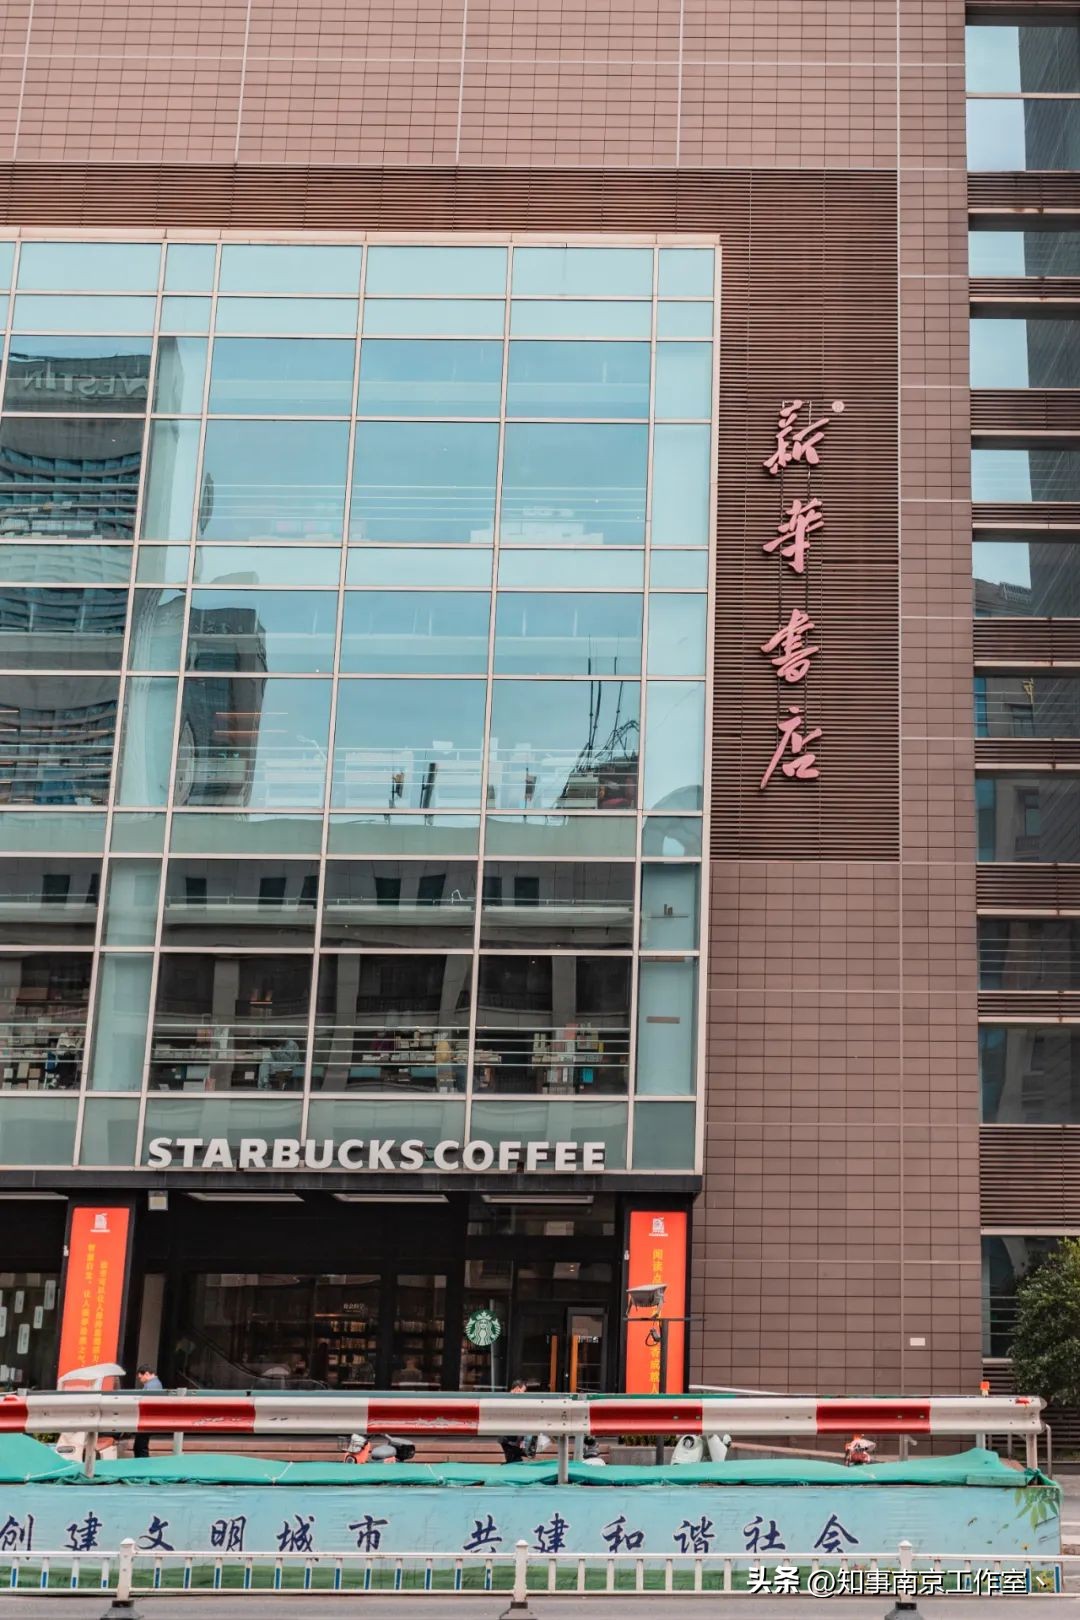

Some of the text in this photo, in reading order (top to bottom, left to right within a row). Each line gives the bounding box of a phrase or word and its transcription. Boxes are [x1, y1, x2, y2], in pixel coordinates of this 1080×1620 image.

[147, 1137, 606, 1173] STARBUCKS COFFEE
[0, 1511, 860, 1554] 创建文明城市 共建和谐社会
